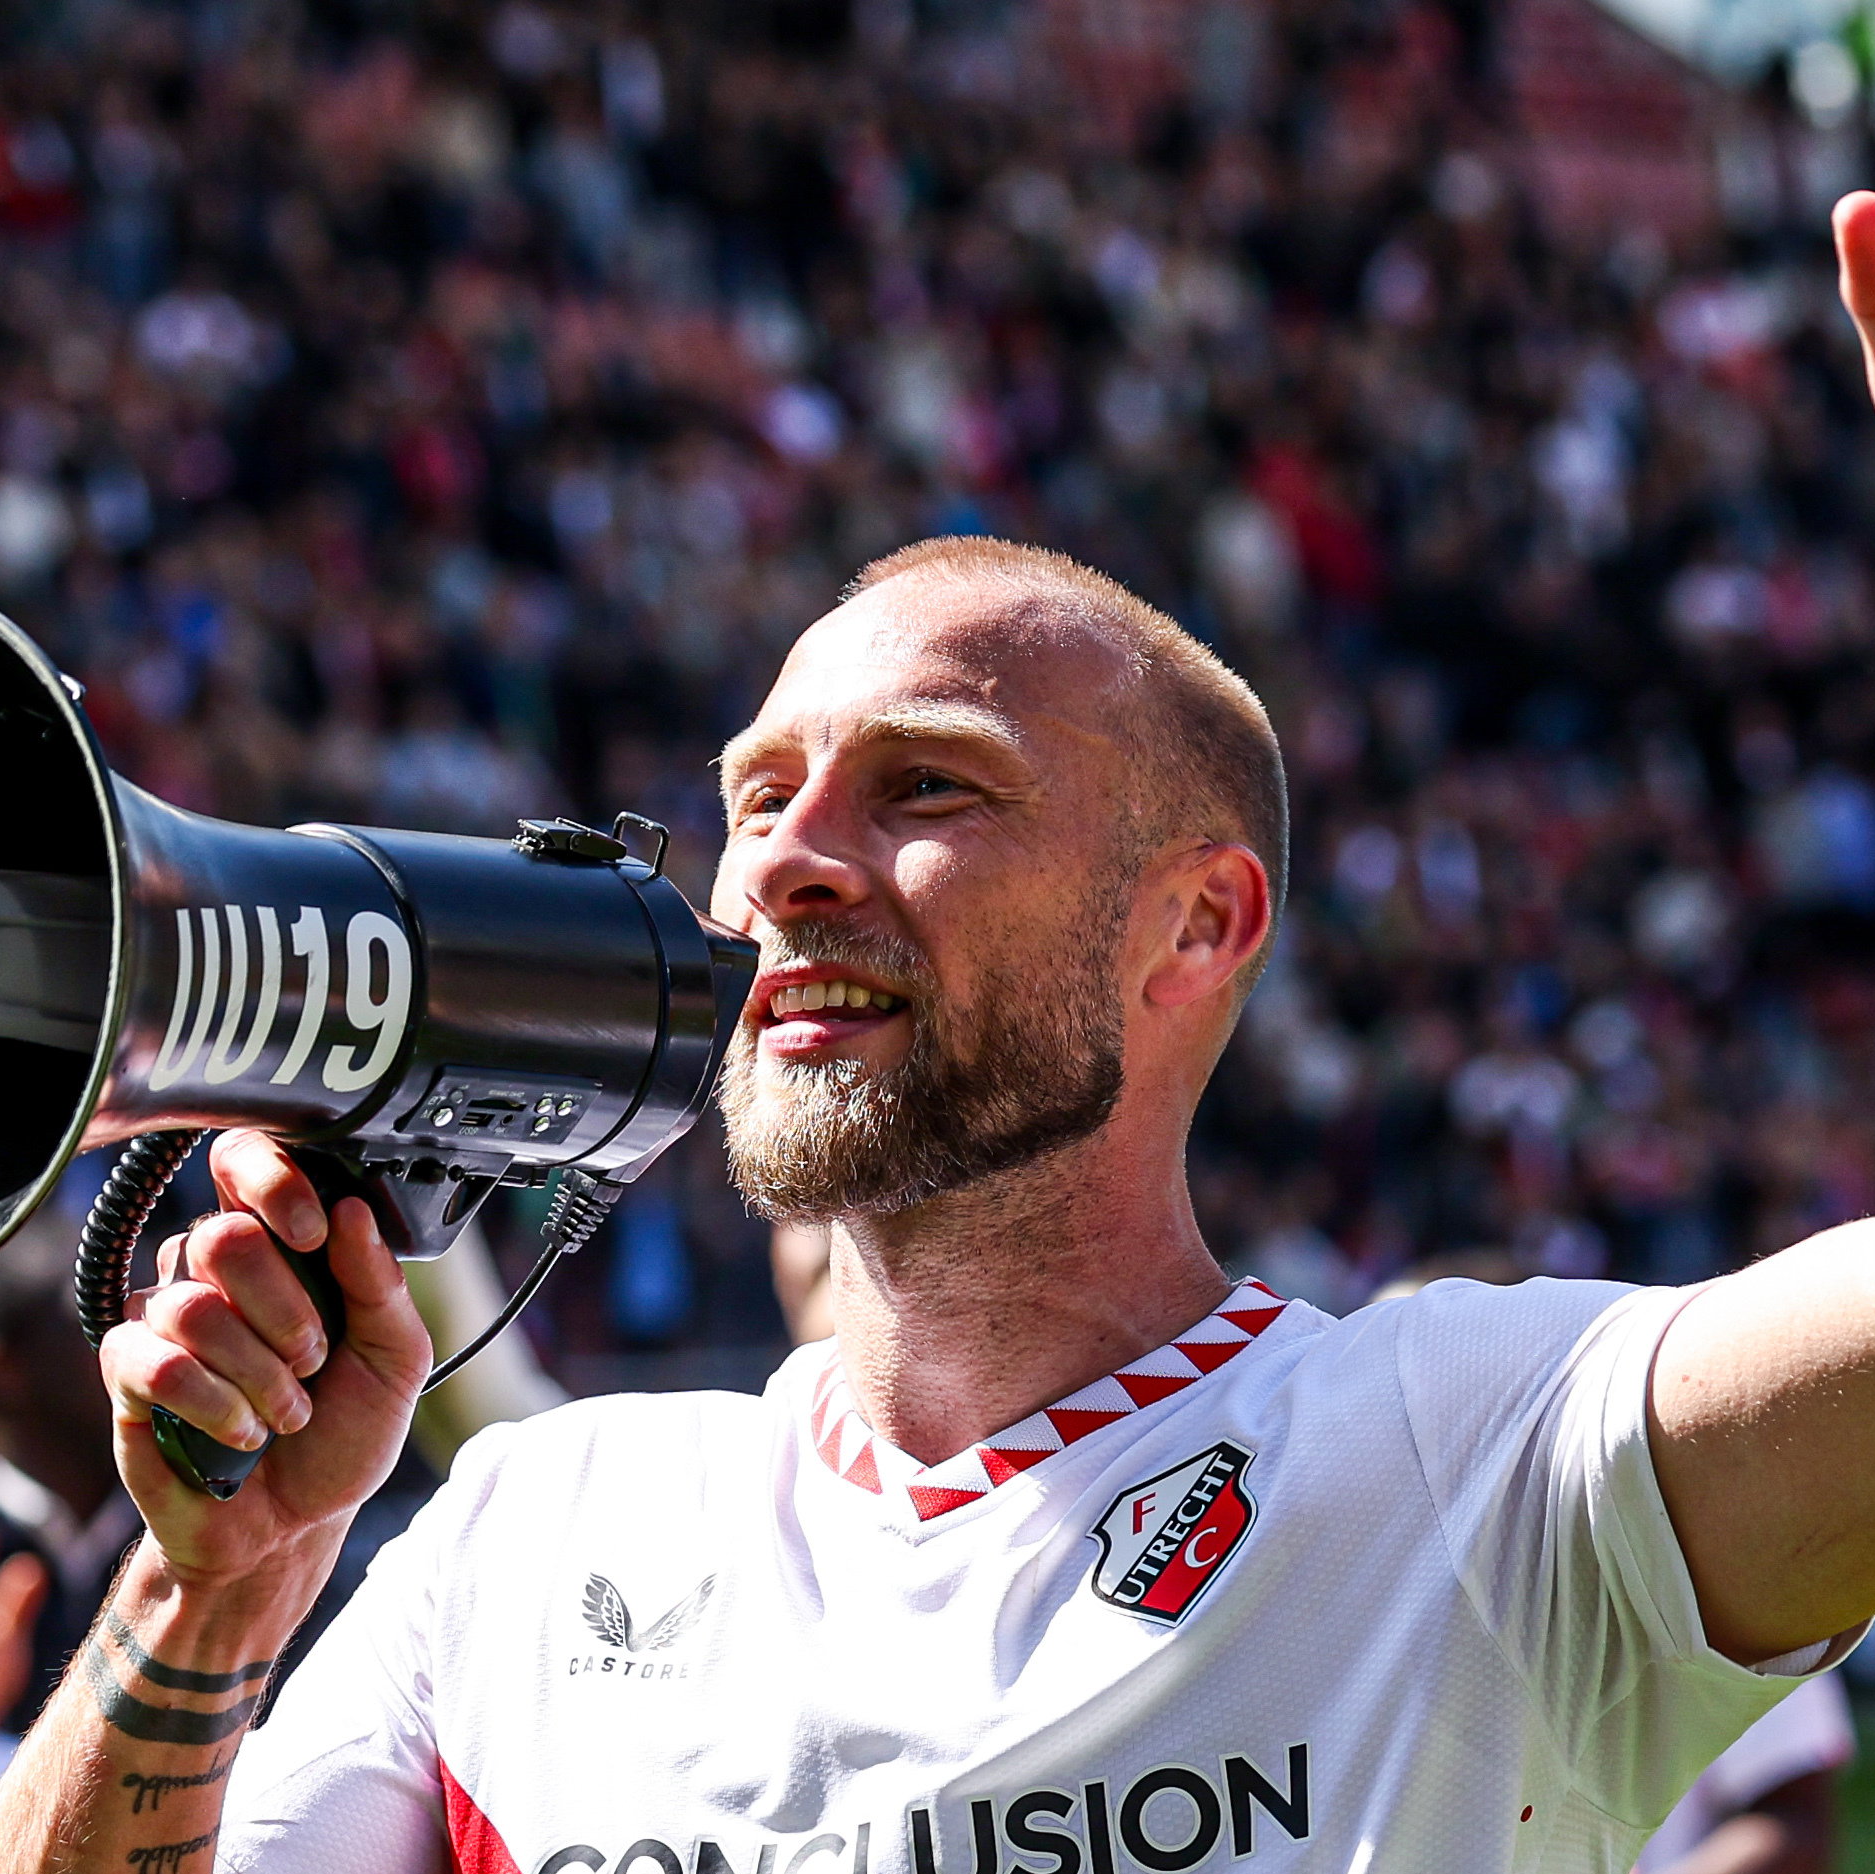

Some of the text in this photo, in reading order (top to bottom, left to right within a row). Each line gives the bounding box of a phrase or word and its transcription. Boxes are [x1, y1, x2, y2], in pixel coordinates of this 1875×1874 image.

[1113, 1452, 1235, 1604] UTRECHT
[1132, 1492, 1157, 1536] F
[1184, 1526, 1218, 1568] C
[568, 1655, 690, 1680] CASTORE
